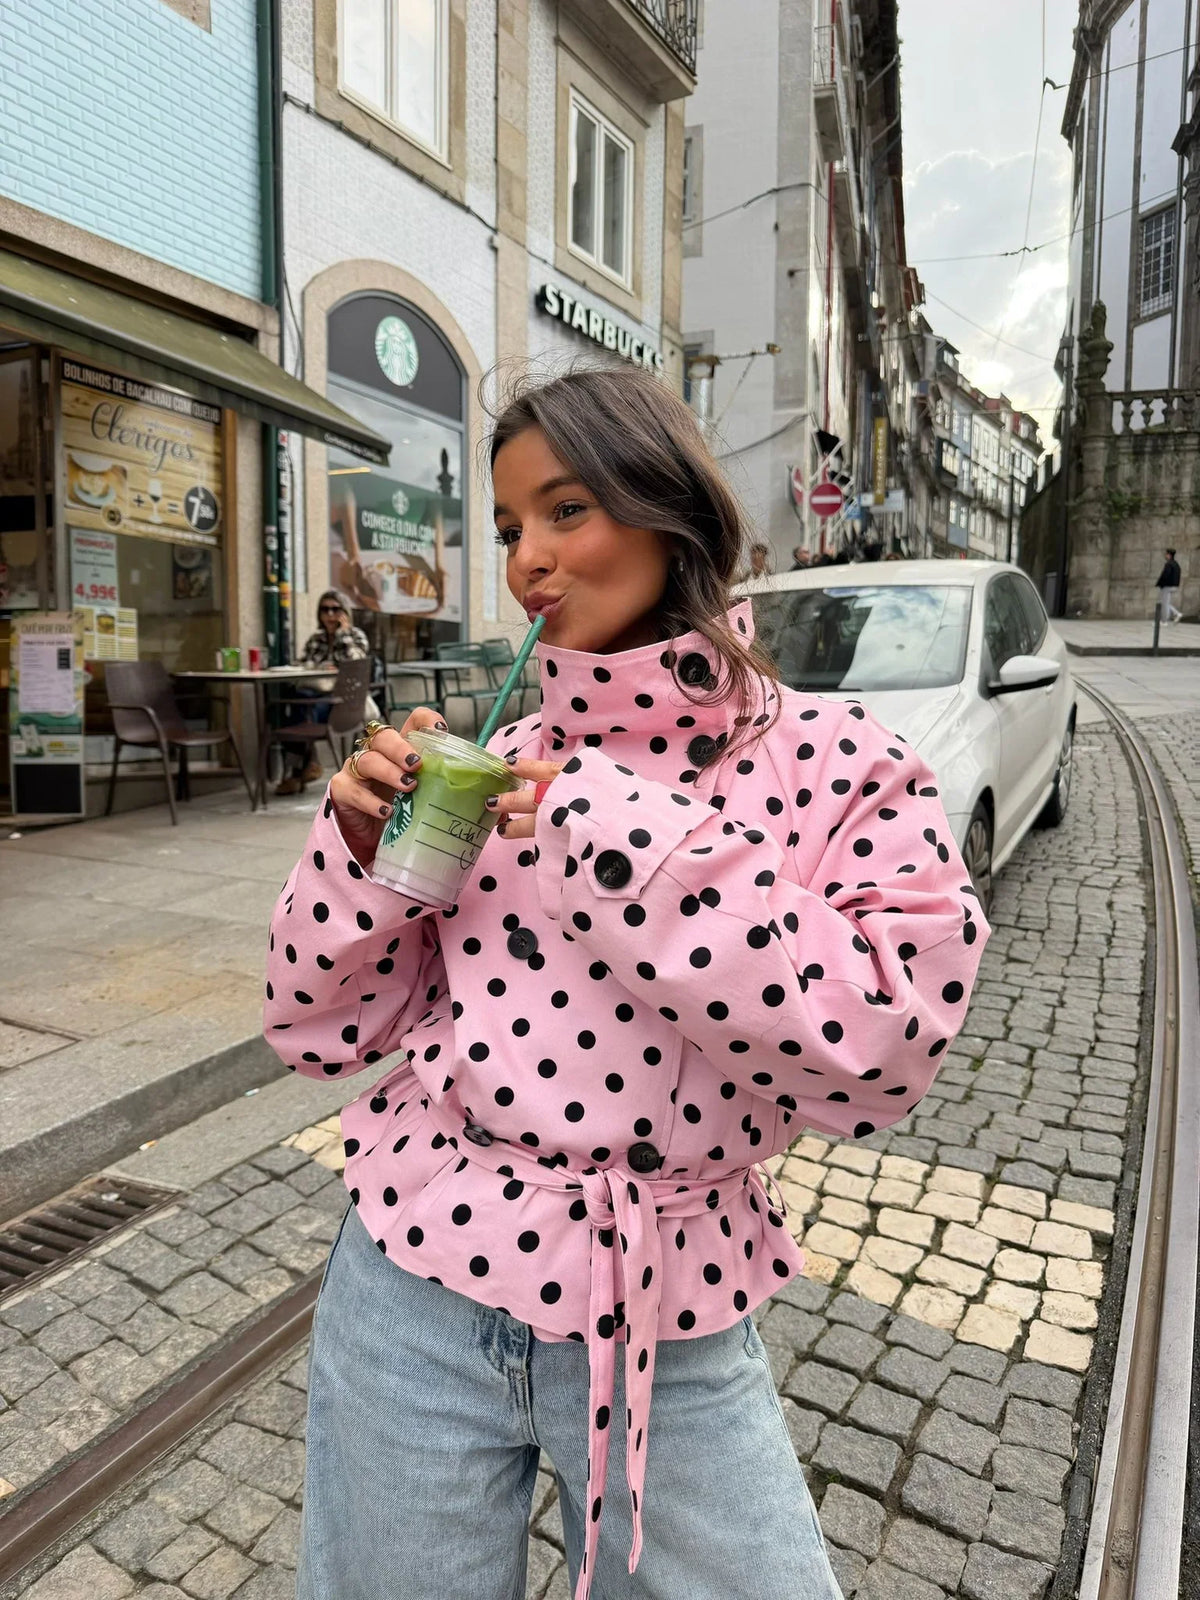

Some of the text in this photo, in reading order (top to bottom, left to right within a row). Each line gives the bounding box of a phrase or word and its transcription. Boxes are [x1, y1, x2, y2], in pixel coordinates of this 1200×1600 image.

[545, 283, 664, 377] STARBUCKS
[64, 362, 111, 390] BOLINHOS
[113, 377, 125, 395] DE
[75, 582, 117, 600] 4,99€
